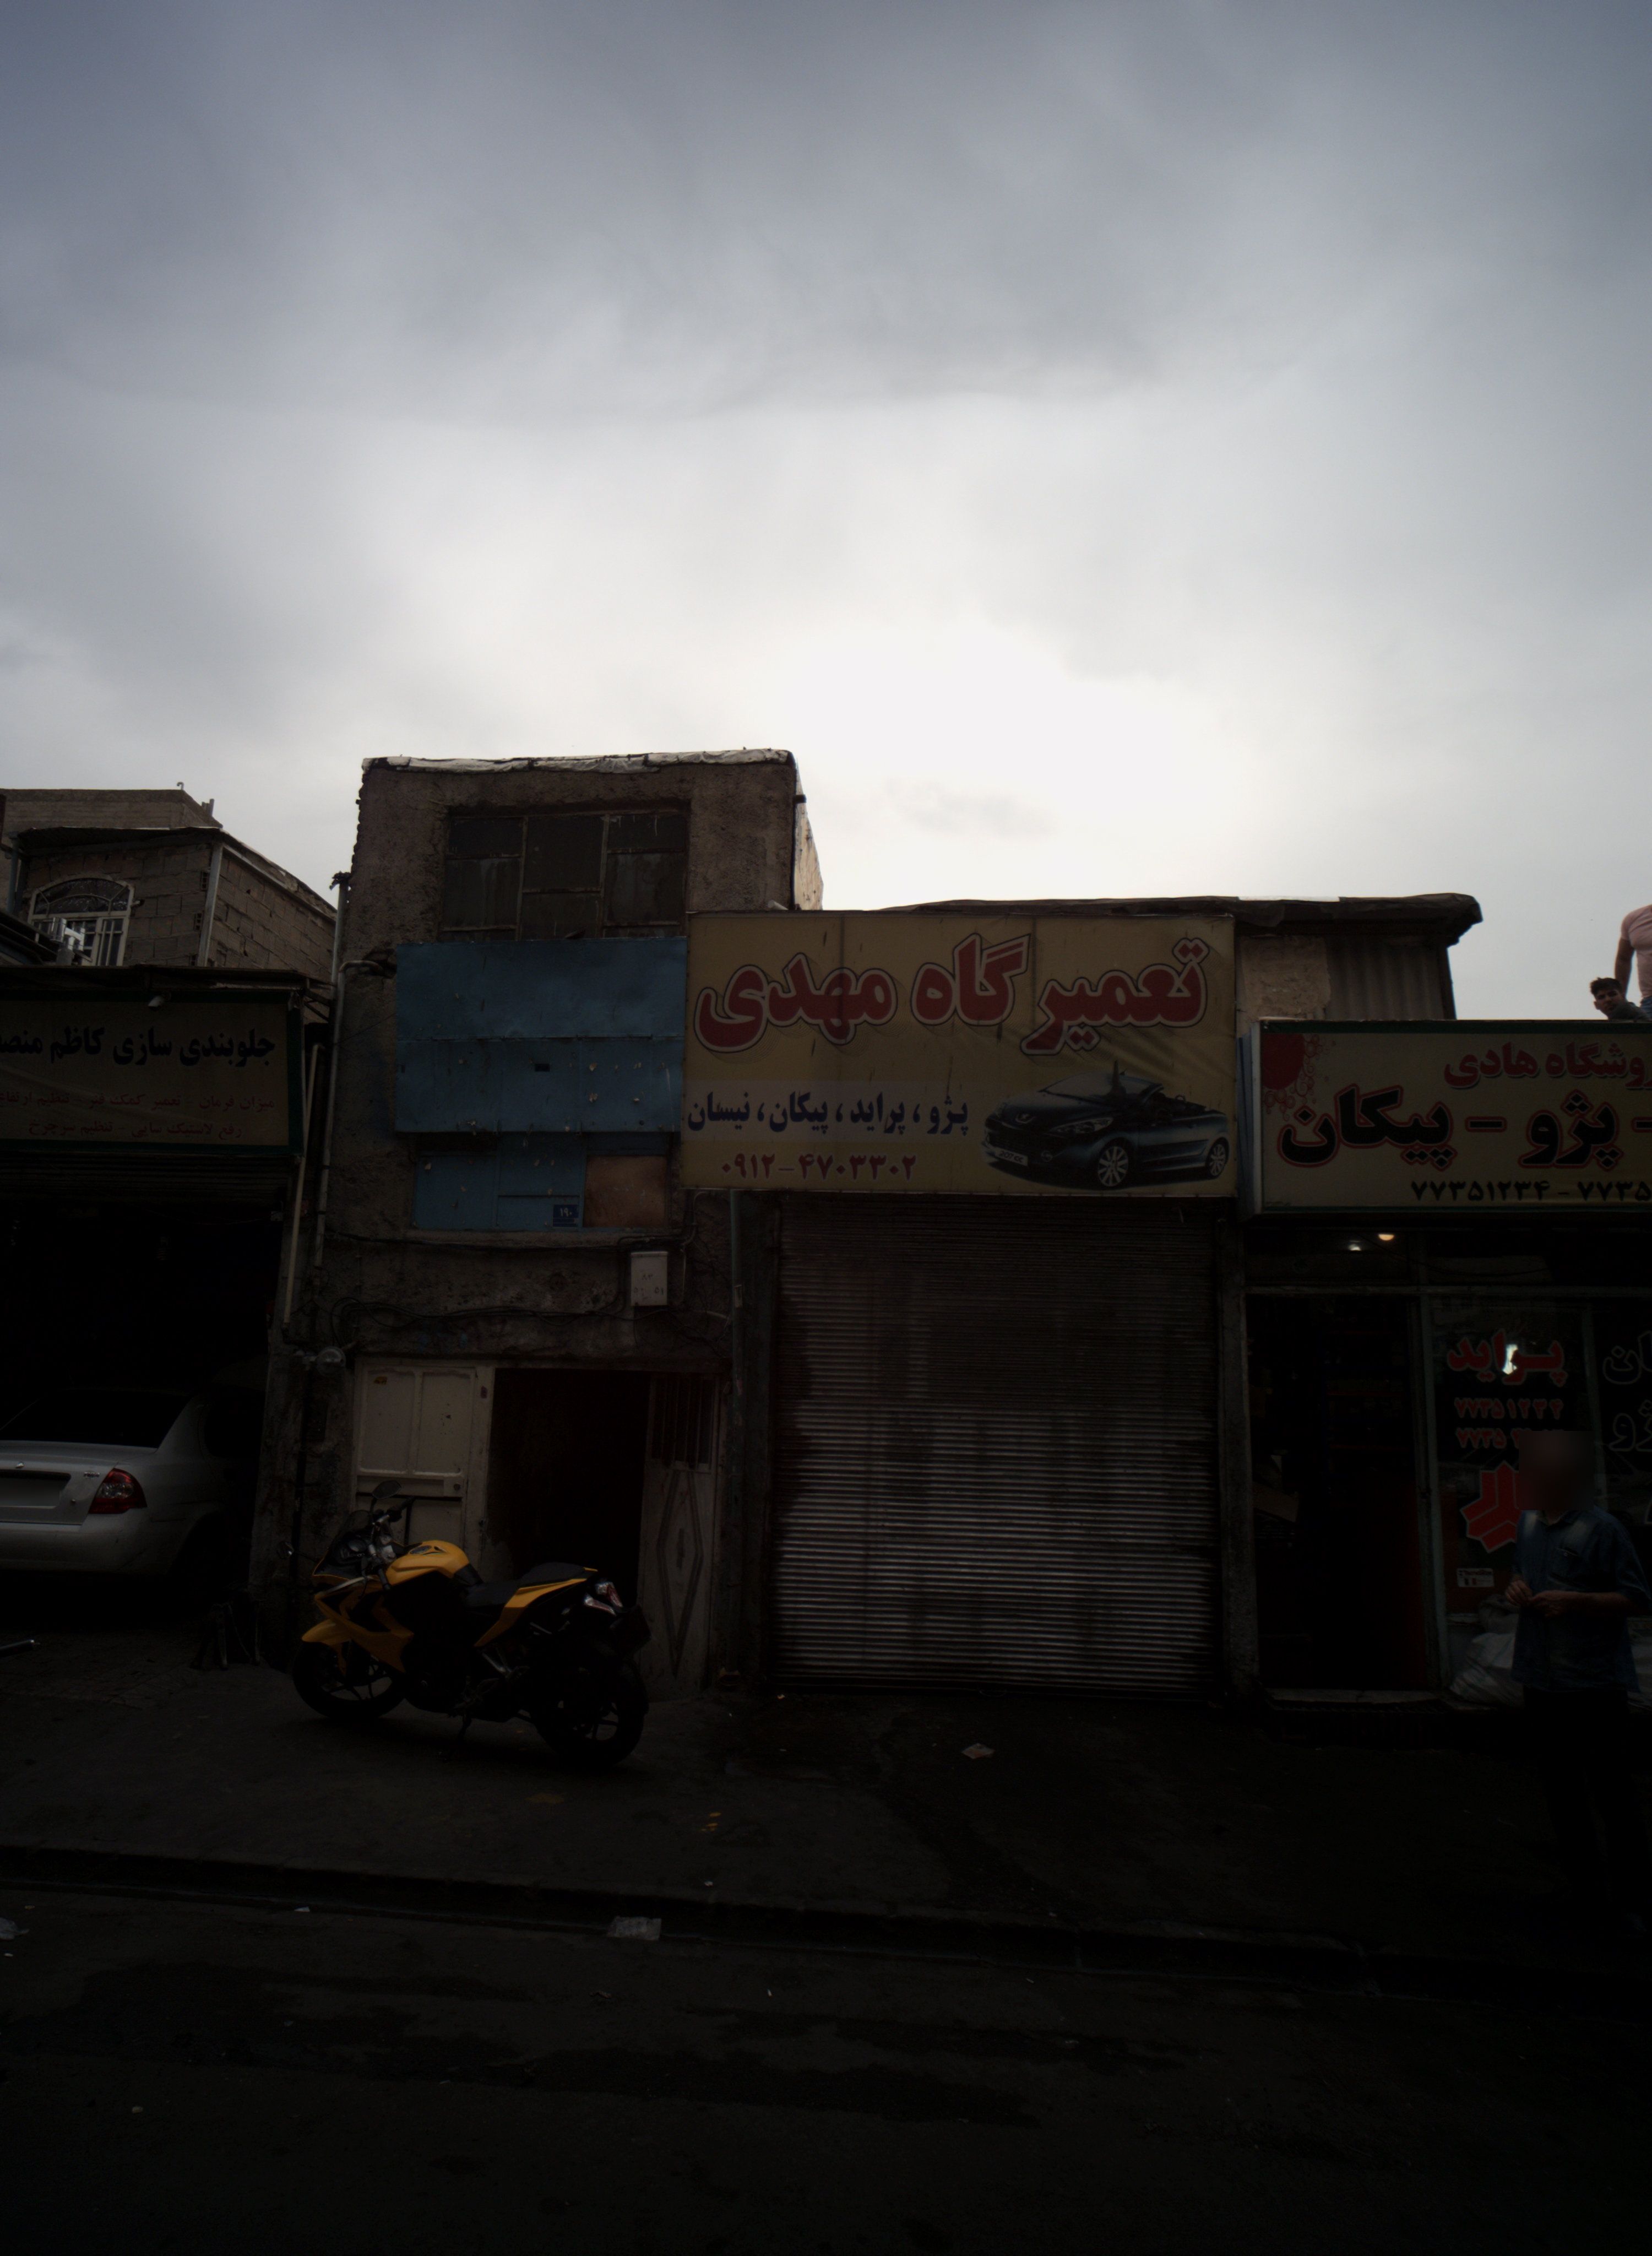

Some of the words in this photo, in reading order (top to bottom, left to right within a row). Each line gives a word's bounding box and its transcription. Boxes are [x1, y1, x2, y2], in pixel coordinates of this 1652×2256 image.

[694, 953, 898, 1053] مهدی
[0, 1032, 42, 1054] منص
[51, 1026, 105, 1064] کاظم
[113, 1028, 171, 1065] سازی
[180, 1029, 275, 1066] جلوبندی
[1443, 1042, 1540, 1089] هادی
[199, 1094, 235, 1112] فرمان
[240, 1096, 275, 1113] میزان
[687, 1091, 751, 1132] نیسان
[1276, 1083, 1458, 1172] پیکان
[1517, 1088, 1624, 1171] پژو
[1447, 1328, 1568, 1388] پراید
